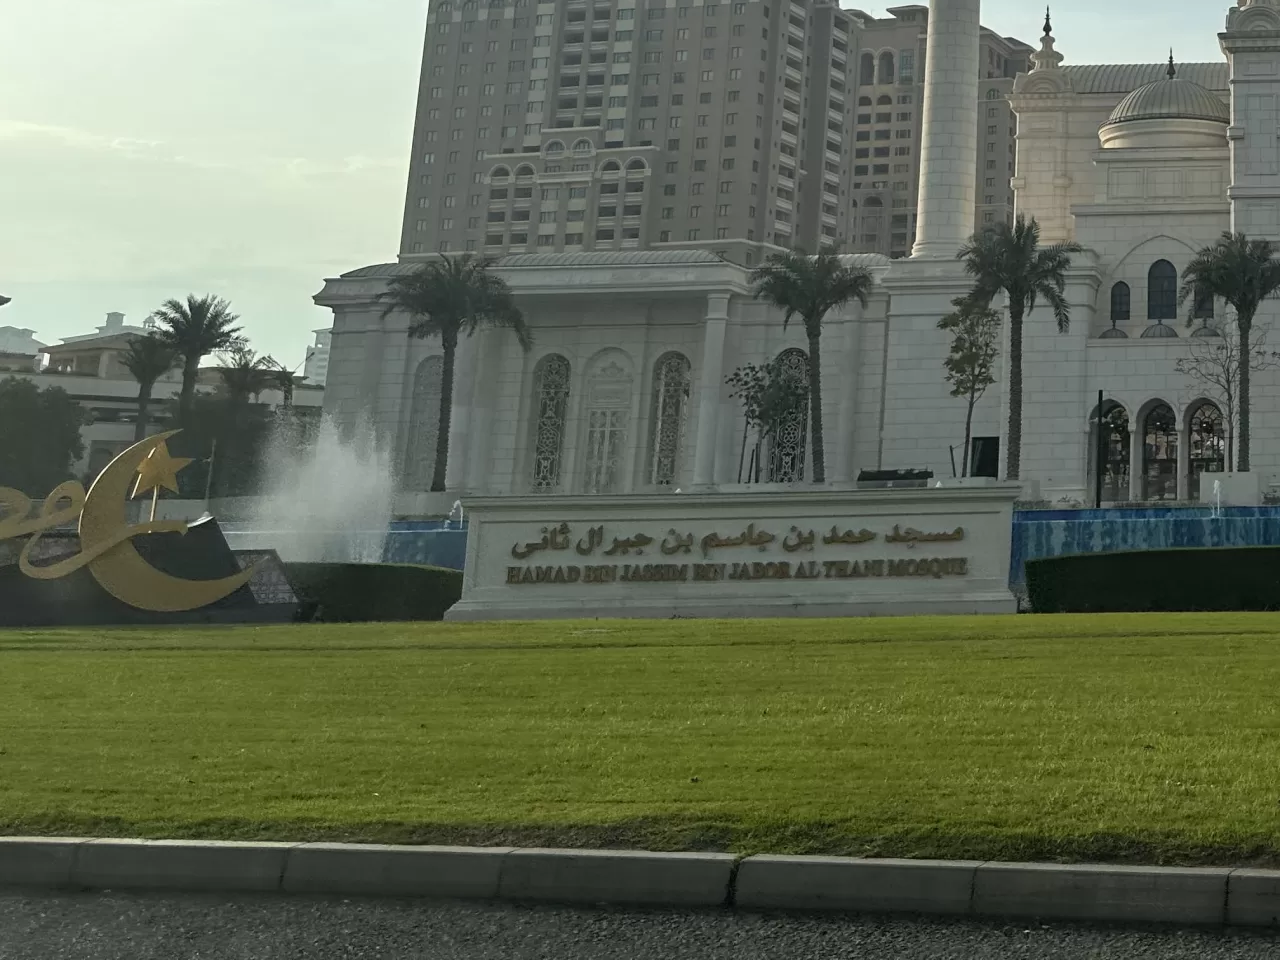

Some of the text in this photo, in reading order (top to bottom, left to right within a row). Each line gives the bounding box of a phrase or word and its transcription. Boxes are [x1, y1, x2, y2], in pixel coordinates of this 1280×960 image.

[604, 532, 654, 556] جبر
[660, 528, 694, 555] بن
[701, 522, 775, 559] جاسم
[783, 525, 815, 552] بن
[823, 525, 877, 545] حمد
[885, 524, 964, 549] مسجد
[505, 557, 968, 584] HAMAD BIN JASSIM BIN JABOR AL THANI MOSQUE
